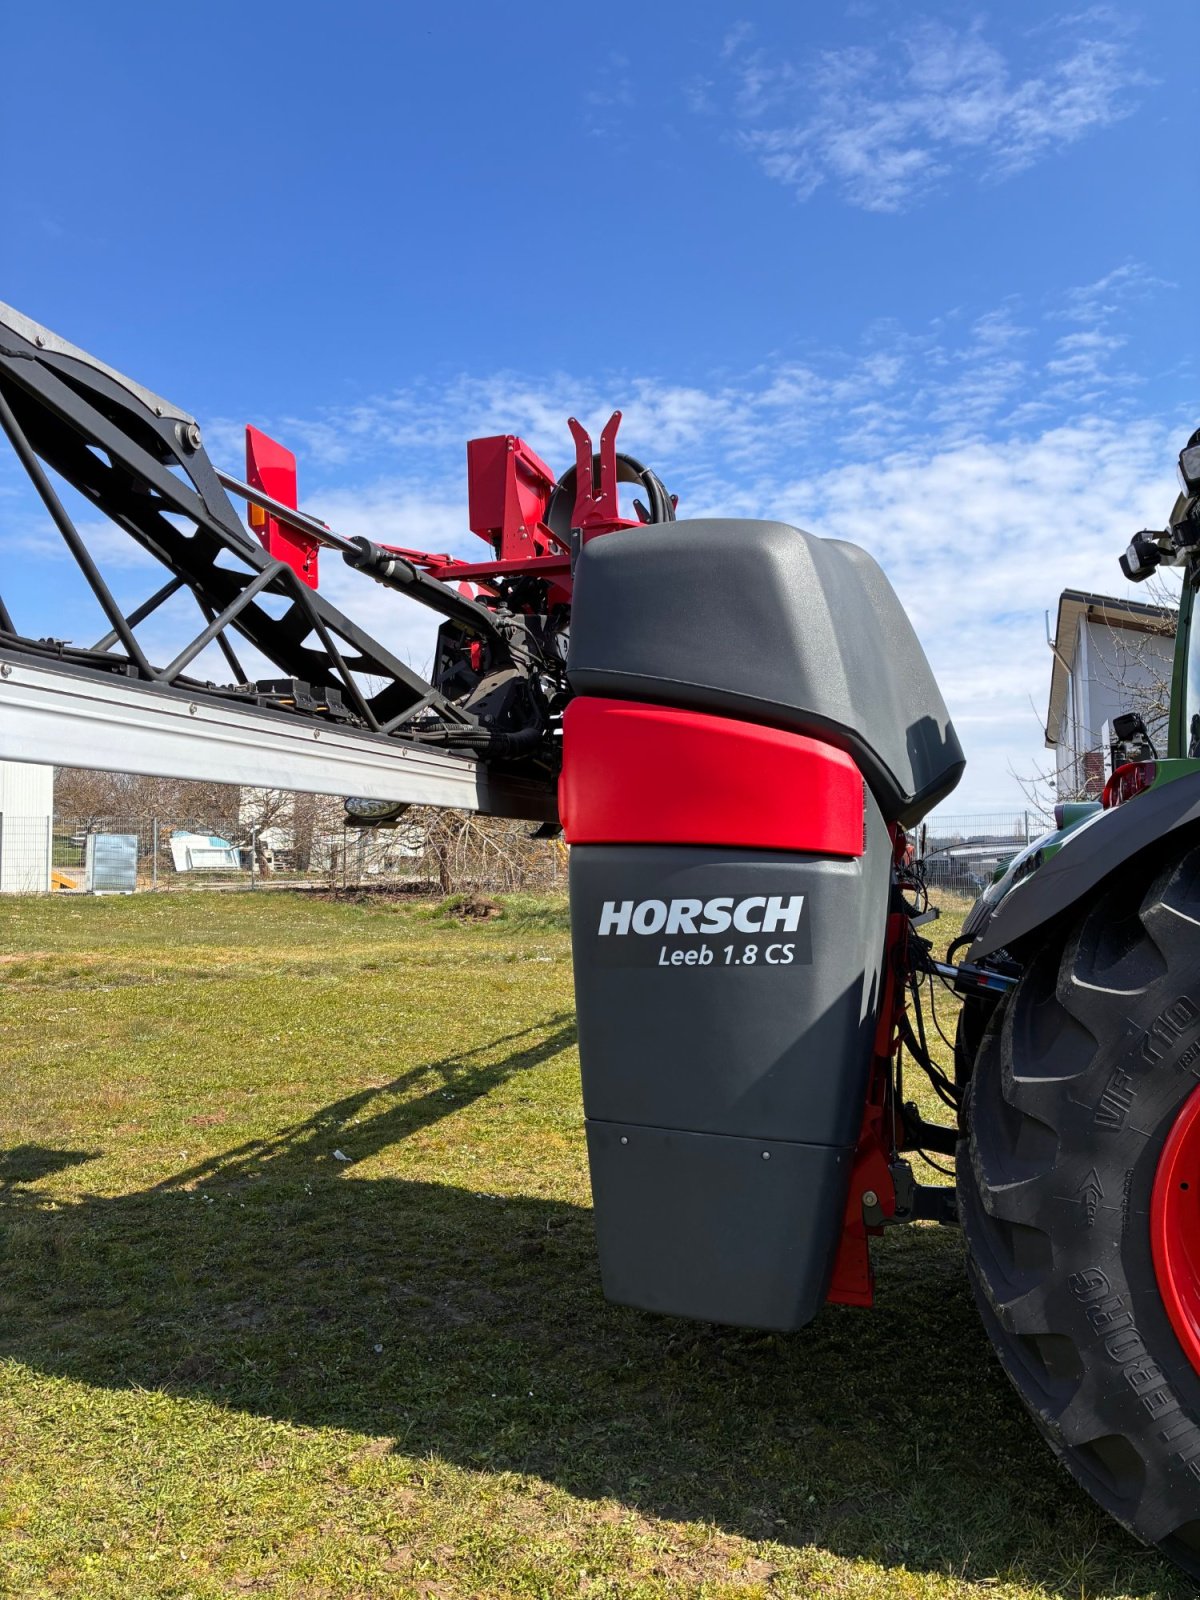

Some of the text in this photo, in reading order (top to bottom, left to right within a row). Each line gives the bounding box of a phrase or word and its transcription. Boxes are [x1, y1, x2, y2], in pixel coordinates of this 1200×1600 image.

[599, 896, 804, 936] HORSCH
[658, 943, 796, 966] Leeb 1.8 CS
[1094, 1065, 1138, 1130] VF
